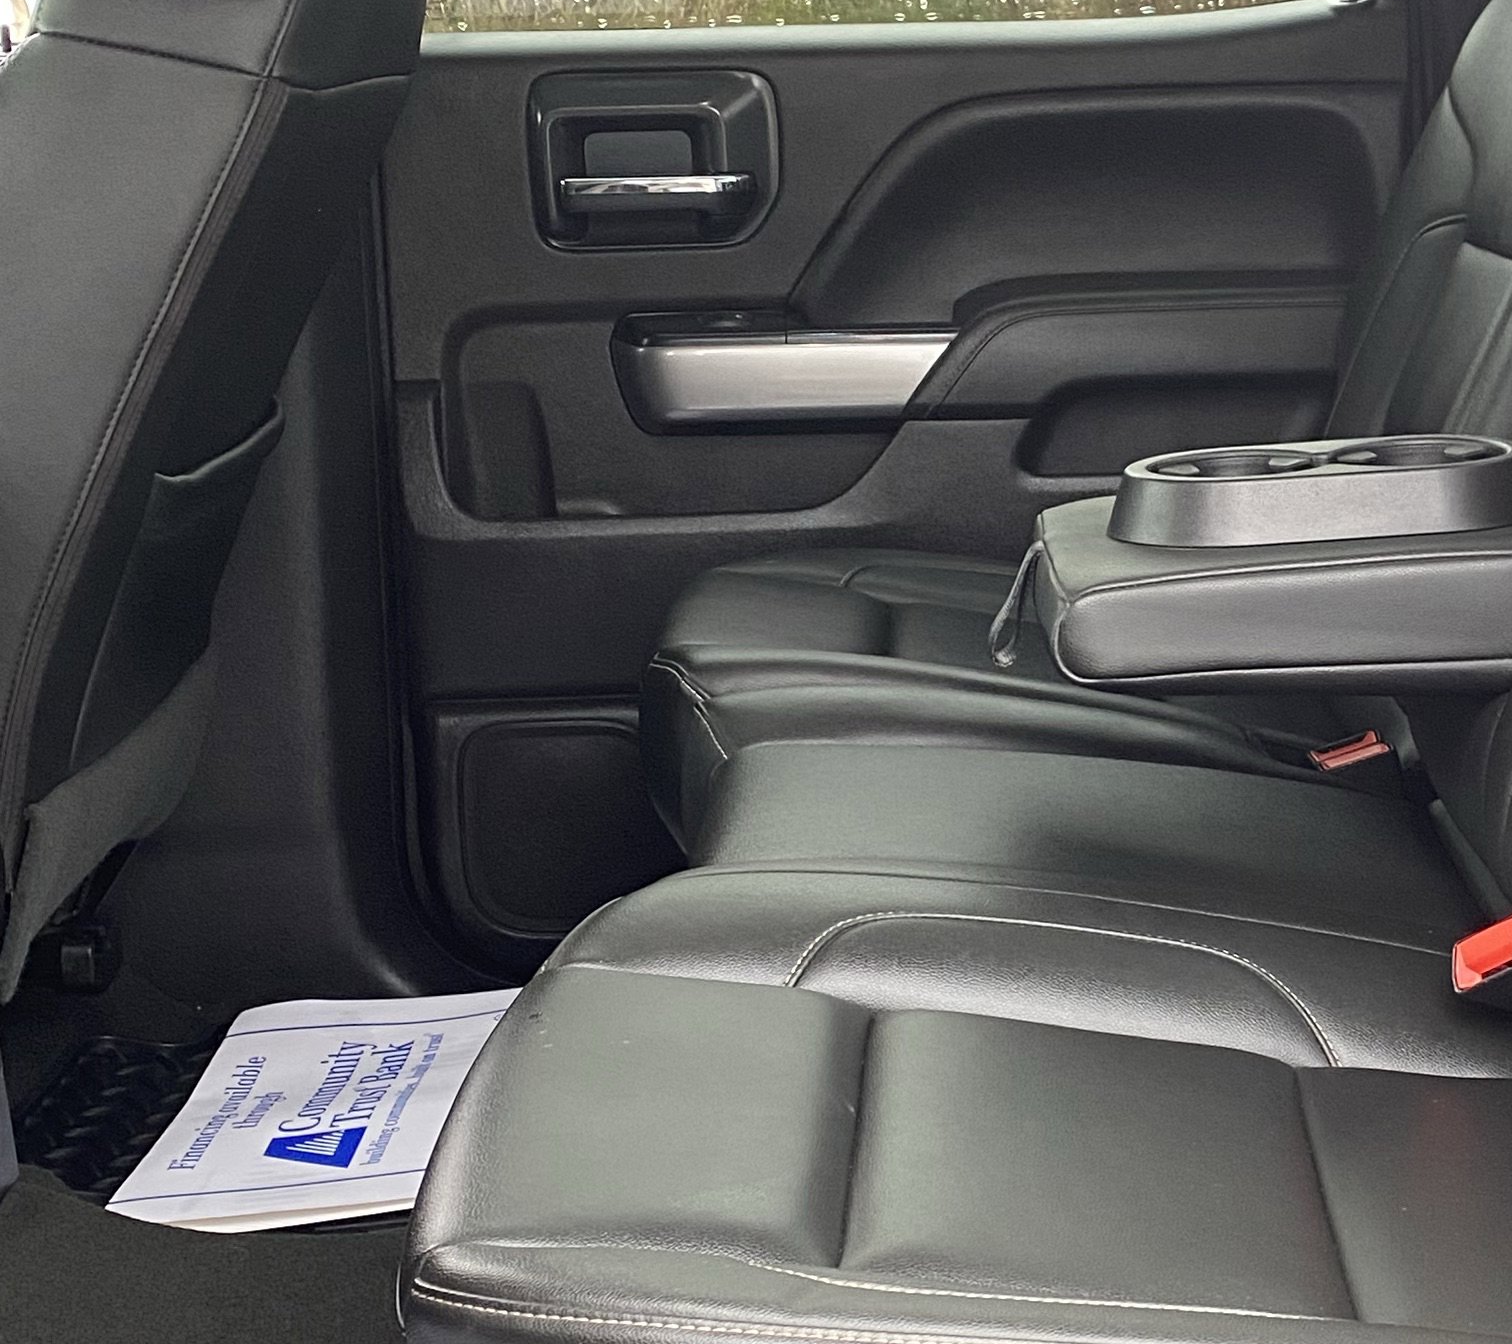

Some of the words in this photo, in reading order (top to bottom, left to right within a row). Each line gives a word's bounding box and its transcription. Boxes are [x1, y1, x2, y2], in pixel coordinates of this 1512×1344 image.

[358, 1040, 415, 1084] Bank
[278, 1041, 377, 1132] Community
[330, 1084, 391, 1128] Trust
[167, 1112, 239, 1170] Financing
[219, 1056, 267, 1113] available
[232, 1091, 287, 1129] through
